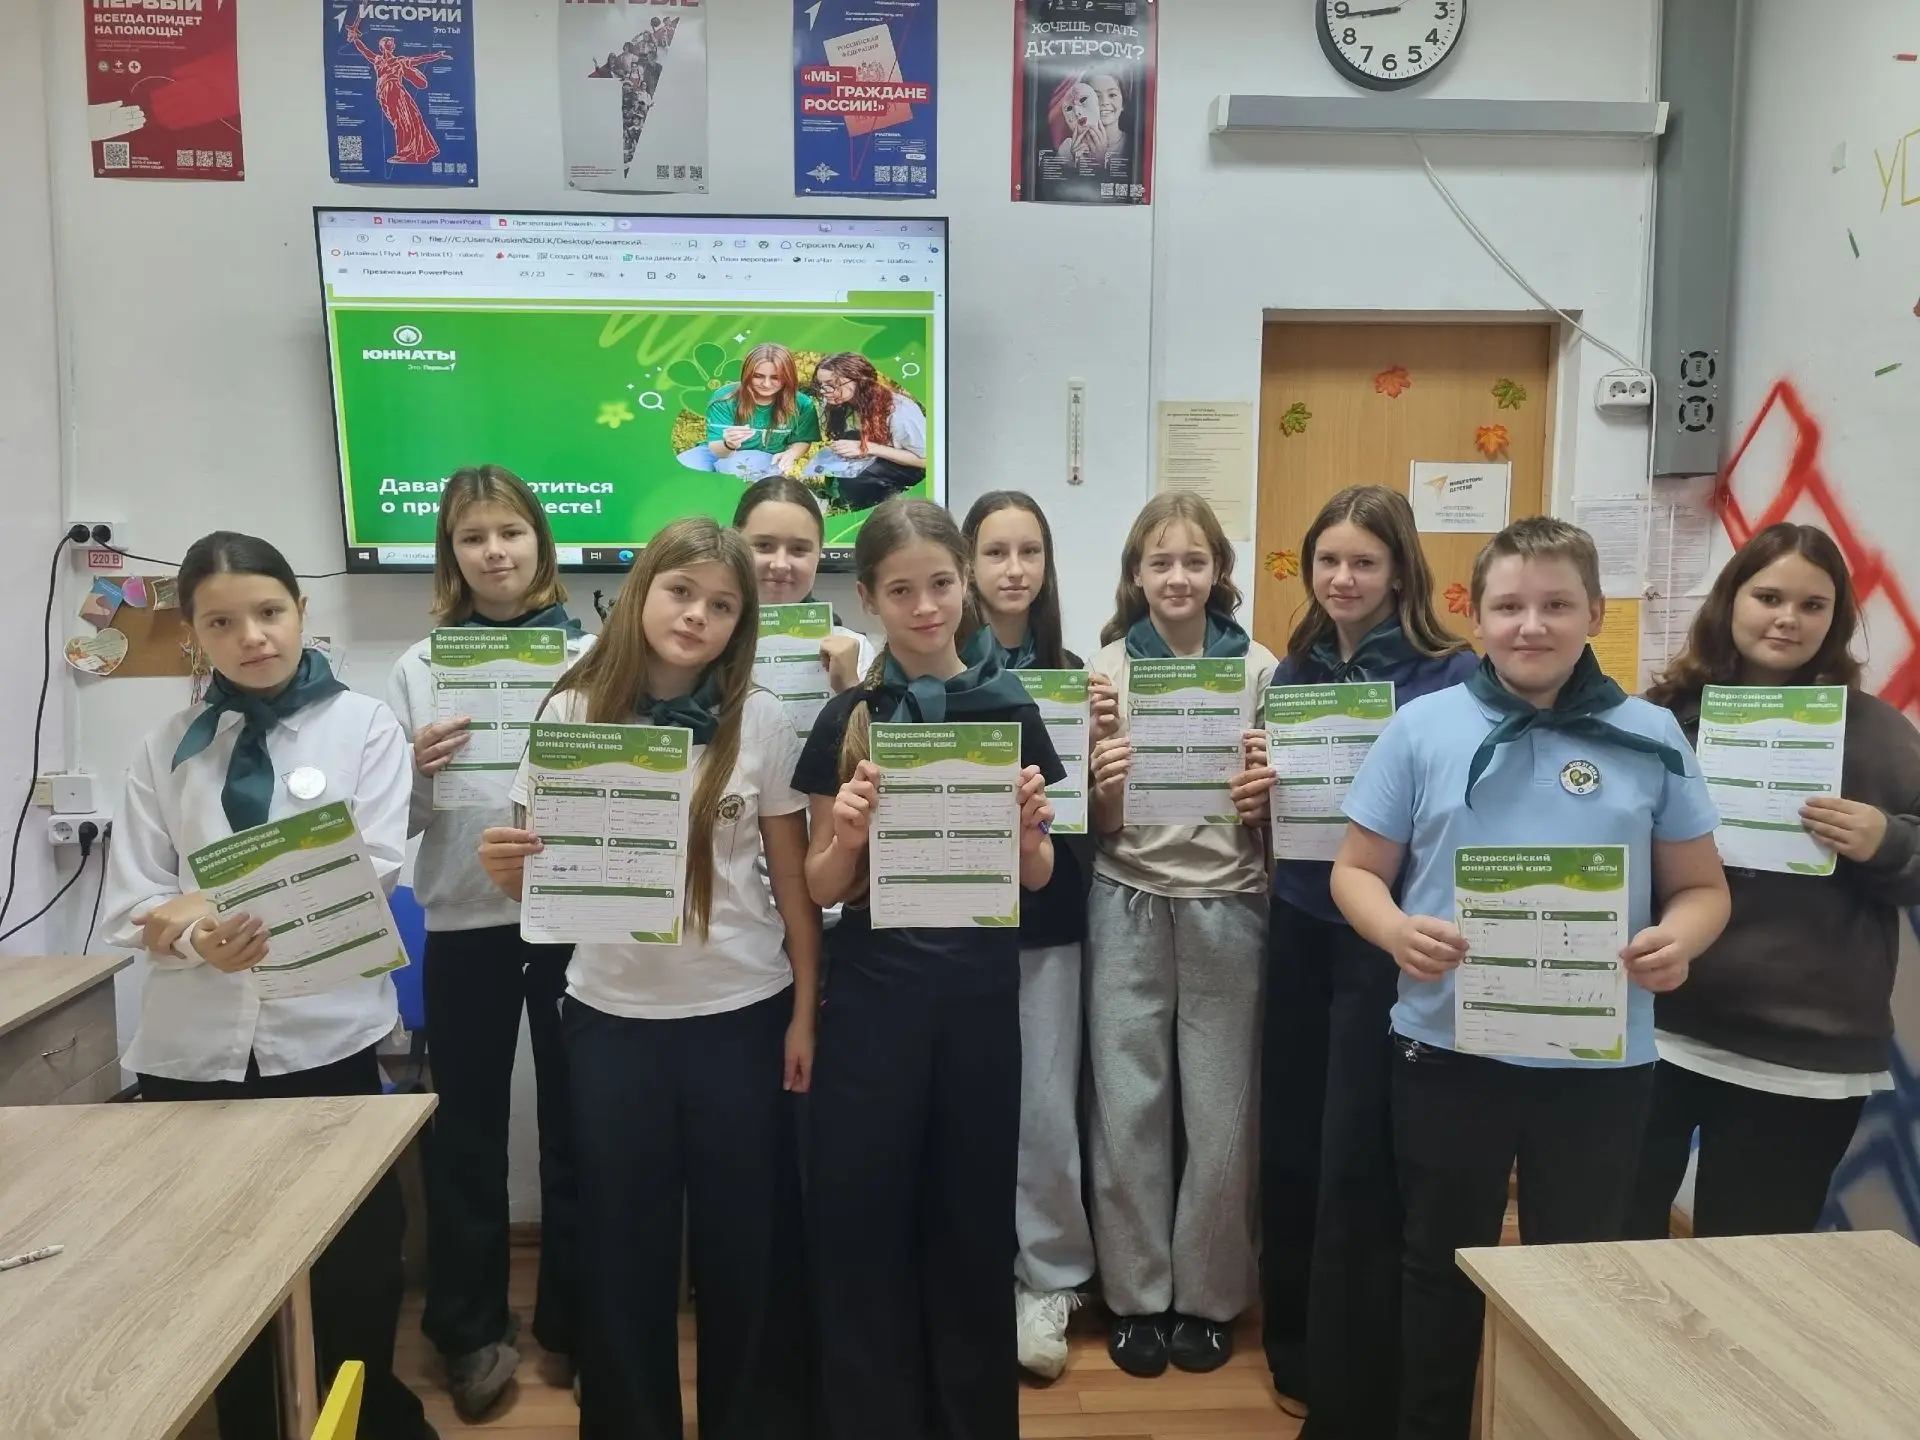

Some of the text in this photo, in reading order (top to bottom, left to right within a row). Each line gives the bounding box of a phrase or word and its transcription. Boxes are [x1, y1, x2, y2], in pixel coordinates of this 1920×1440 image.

[358, 5, 462, 23] ИСТОРИИ
[1334, 1, 1349, 19] 9
[1434, 1, 1449, 20] 3
[94, 13, 202, 26] ВСЕГДА ПРИДЕТ
[94, 26, 183, 37] НА ПОМОЩЬ!
[433, 26, 447, 34] Это
[1032, 21, 1139, 37] ХОЧЕШЬ СТАТЬ
[1342, 27, 1357, 45] 8
[1424, 28, 1440, 46] 4
[1024, 36, 1145, 60] АКТЁРОМ?
[1360, 45, 1374, 63] 7
[1407, 45, 1422, 64] 5
[1381, 53, 1398, 72] 6
[804, 70, 840, 83] «МЫ
[836, 85, 927, 99] ГРАЖДАНЕ
[804, 99, 885, 112] РОССИИ!»
[362, 349, 456, 360] ЮННАТЫ
[379, 478, 613, 495] Давай отиться
[381, 500, 602, 517] о при есте!
[92, 553, 120, 565] 220 В
[436, 633, 508, 642] Всероссийский
[1268, 690, 1336, 700] Всероссийский
[536, 729, 622, 741] Всероссийский
[876, 730, 956, 740] Всероссийский
[536, 741, 623, 751] юннатский квиз
[194, 827, 281, 865] Всероссийский
[1461, 853, 1551, 863] Всероссийский
[1461, 863, 1524, 872] юннатский
